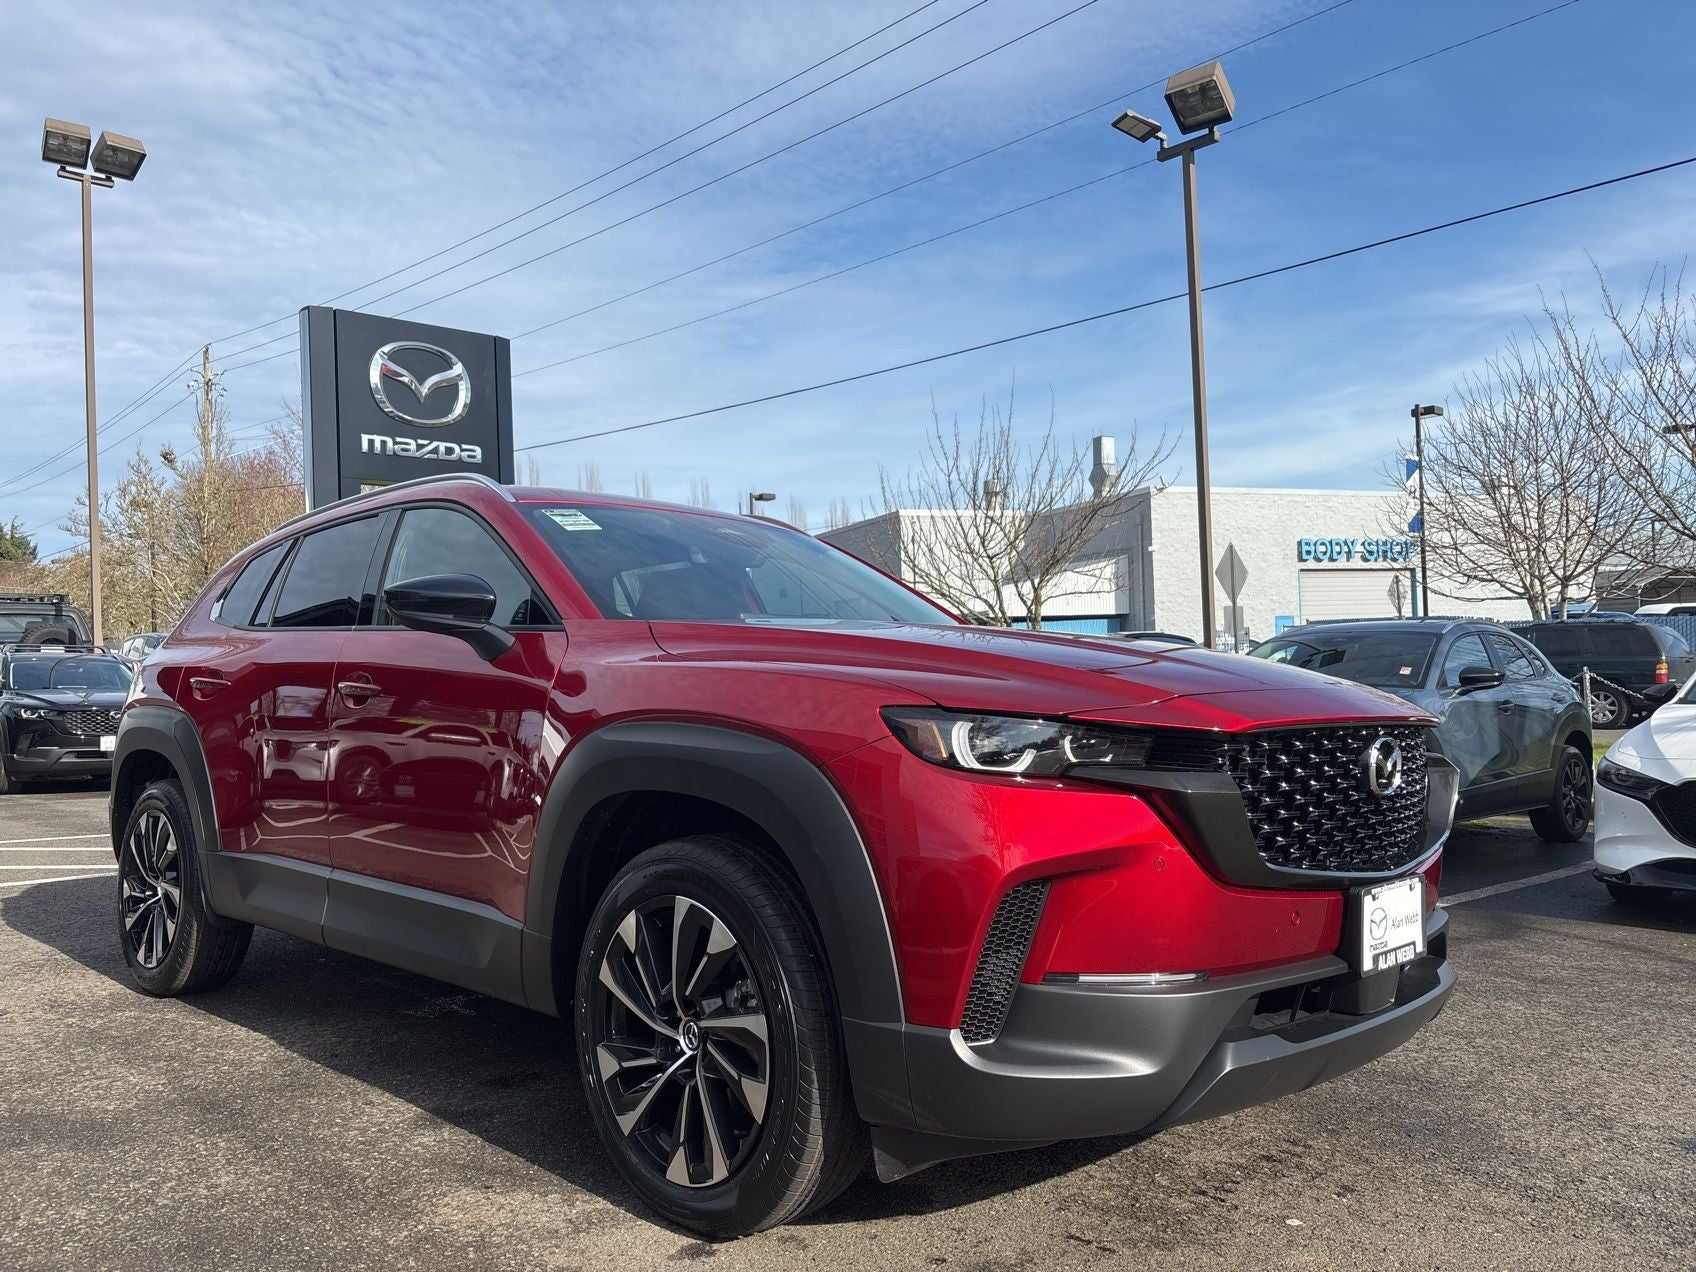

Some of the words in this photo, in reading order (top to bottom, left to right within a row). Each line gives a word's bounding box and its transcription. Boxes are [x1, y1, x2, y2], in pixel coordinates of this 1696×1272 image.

[1299, 537, 1358, 561] BODY
[1361, 537, 1419, 561] SHOP
[1391, 917, 1403, 930] Alan
[1404, 911, 1418, 925] Webb
[1378, 951, 1395, 970] ALAN
[1396, 945, 1414, 963] WEBB
